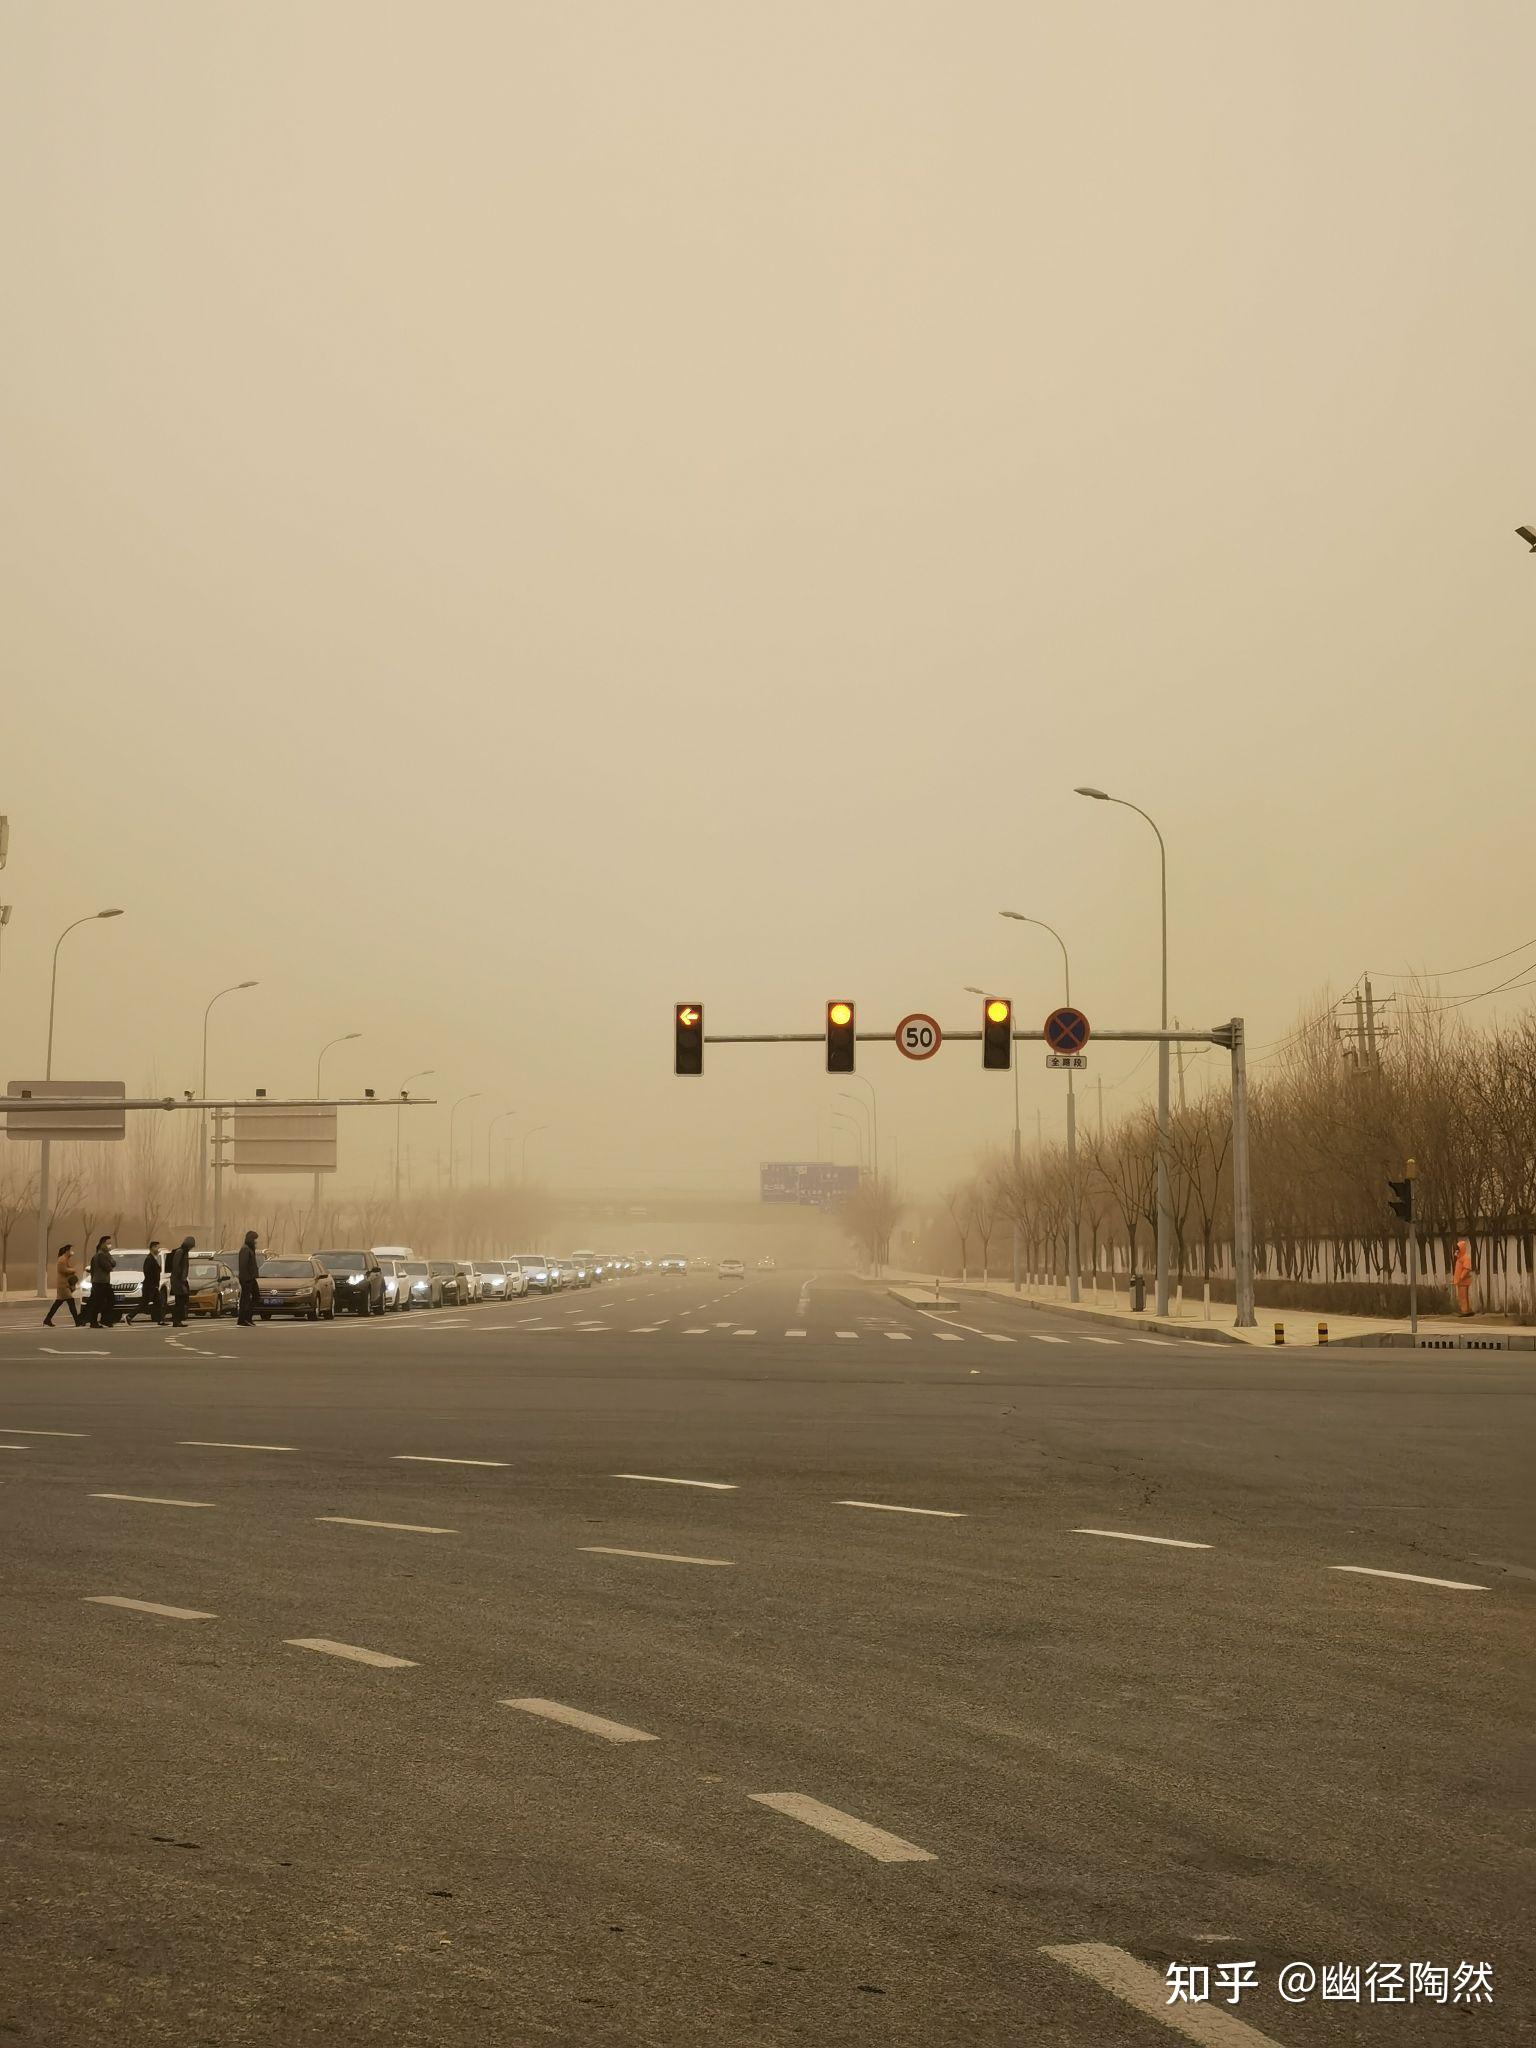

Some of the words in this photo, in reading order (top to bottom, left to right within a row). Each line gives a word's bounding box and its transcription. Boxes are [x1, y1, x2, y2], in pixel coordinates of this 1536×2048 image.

[906, 1027, 933, 1048] 50
[1051, 1057, 1083, 1067] 全路段
